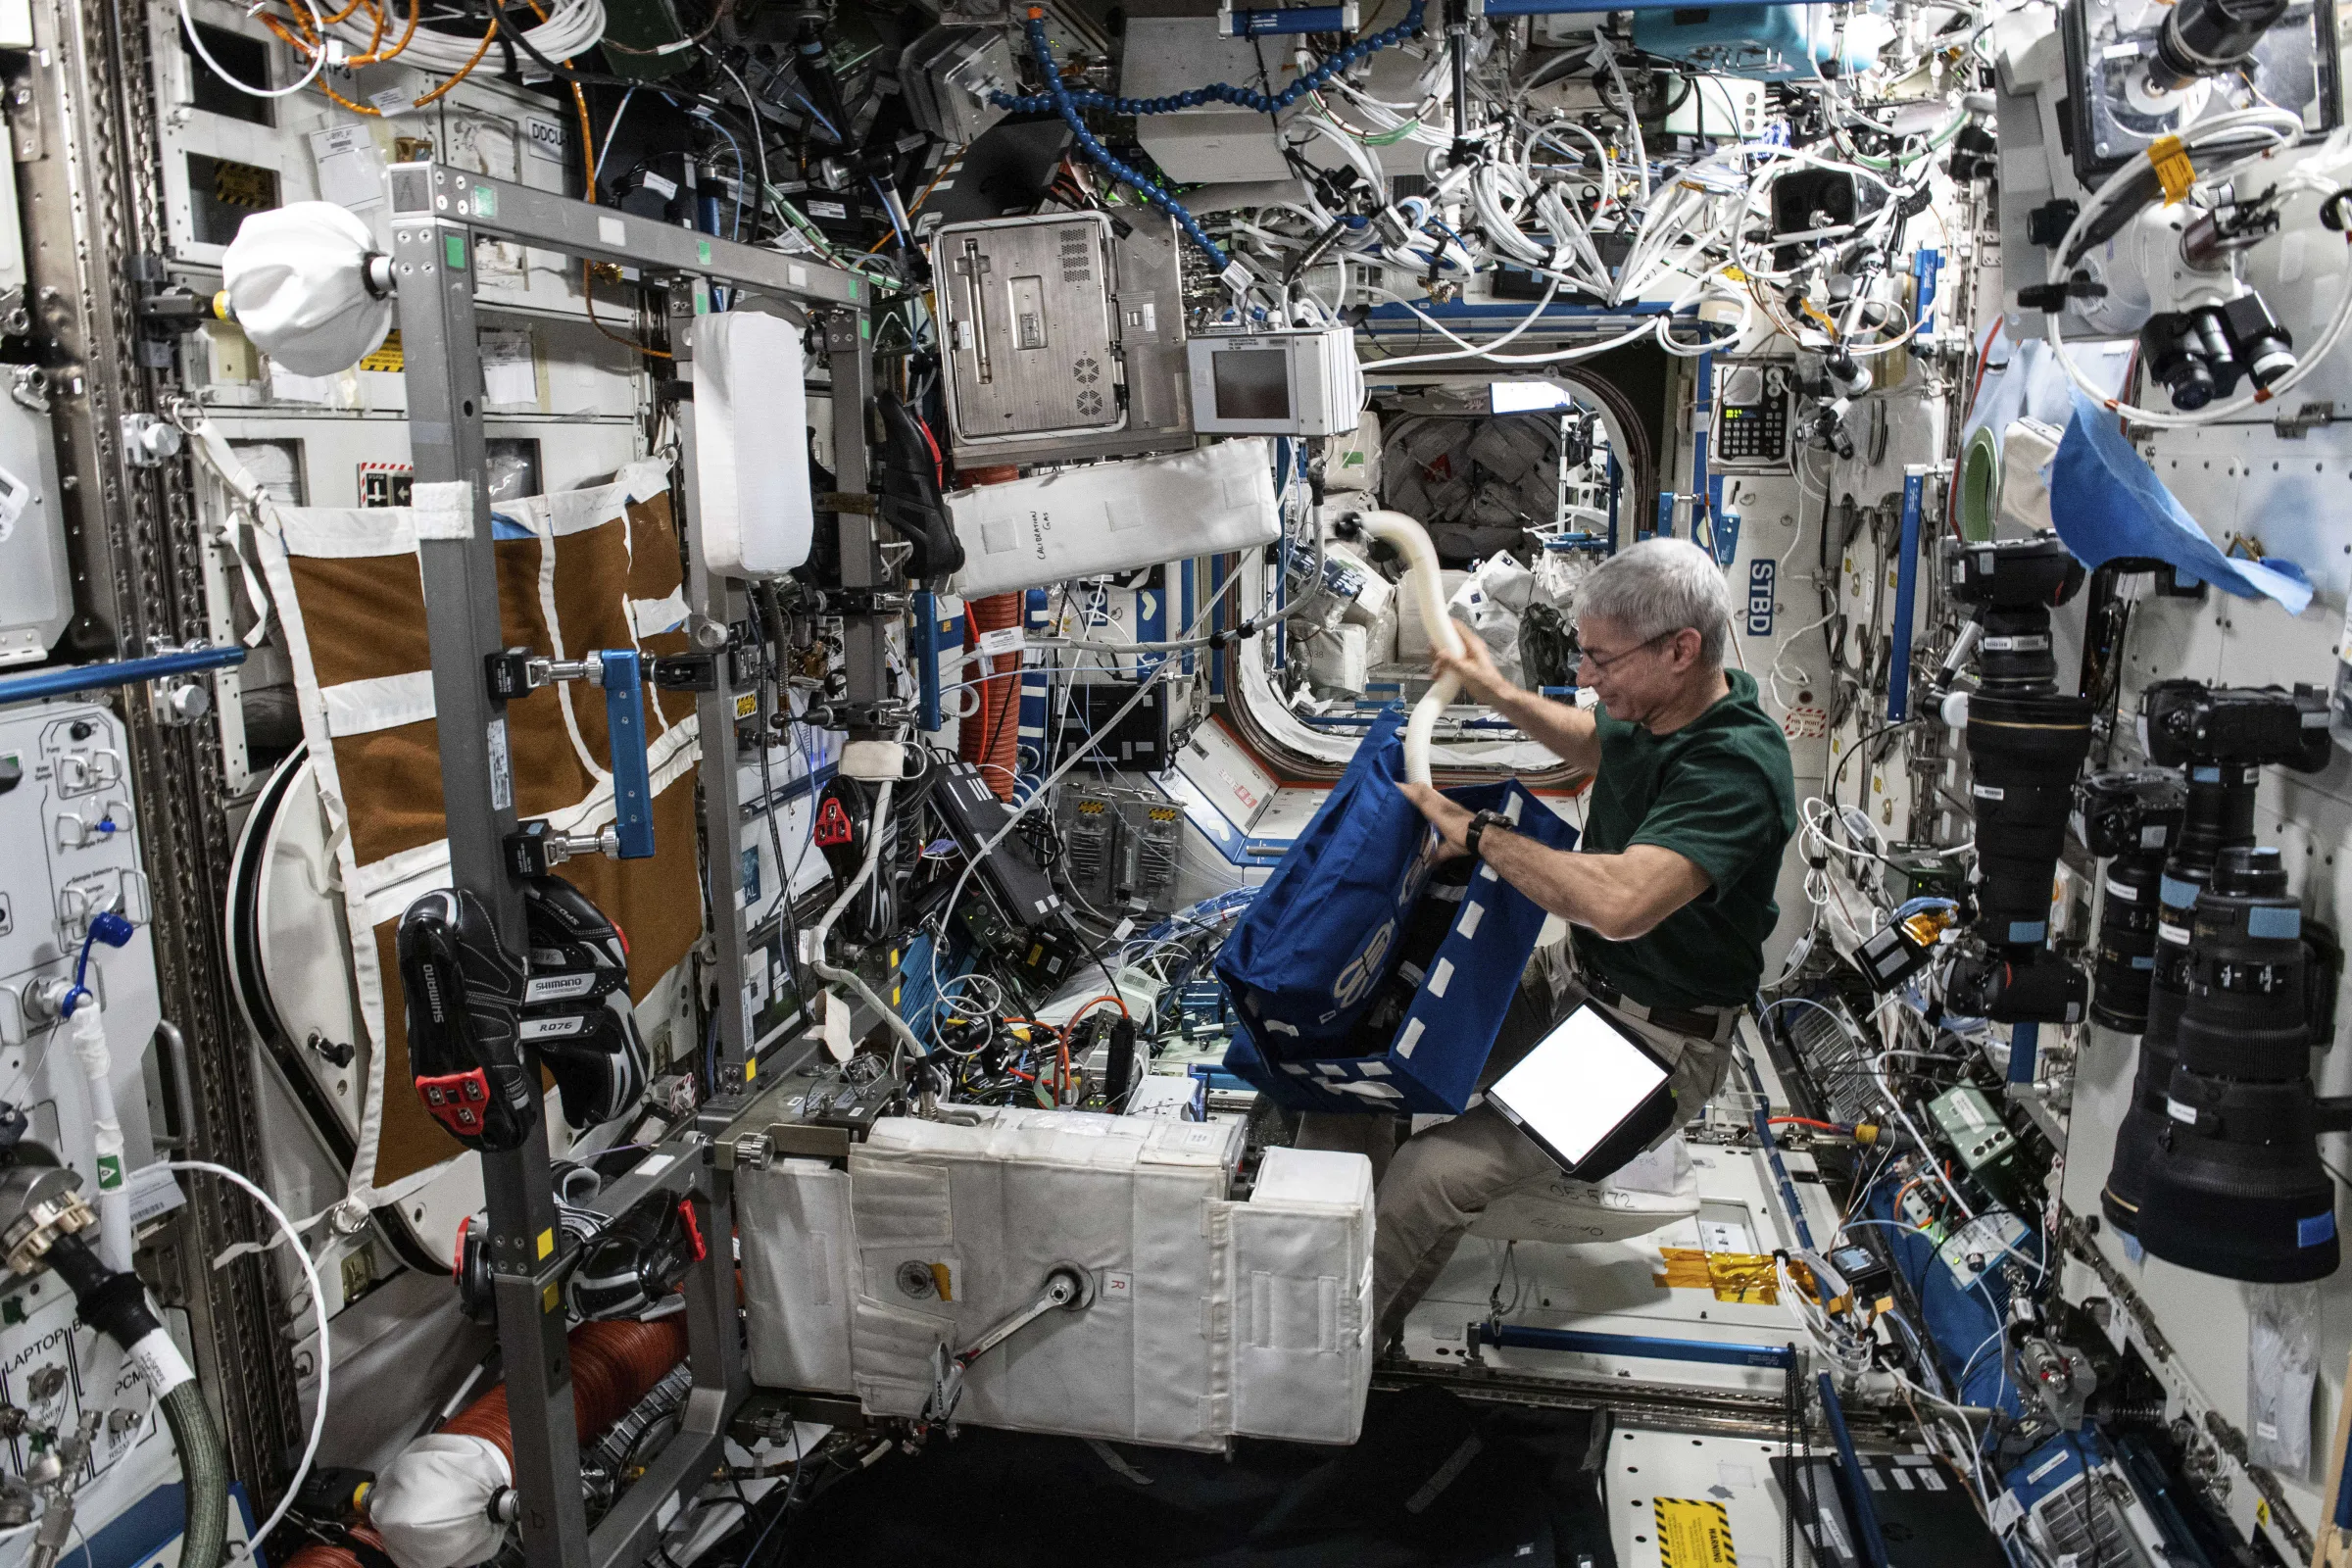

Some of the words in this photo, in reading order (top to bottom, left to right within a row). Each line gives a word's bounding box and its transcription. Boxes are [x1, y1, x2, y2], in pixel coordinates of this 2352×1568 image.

[1029, 511, 1046, 560] CALIBRATION
[1749, 563, 1773, 632] STBD
[423, 963, 444, 1023] SHIMANO
[535, 978, 582, 991] SHIMANO
[1111, 1280, 1125, 1290] R
[4, 1328, 65, 1375] LAPTOP
[1709, 1528, 1723, 1563] WARNING
